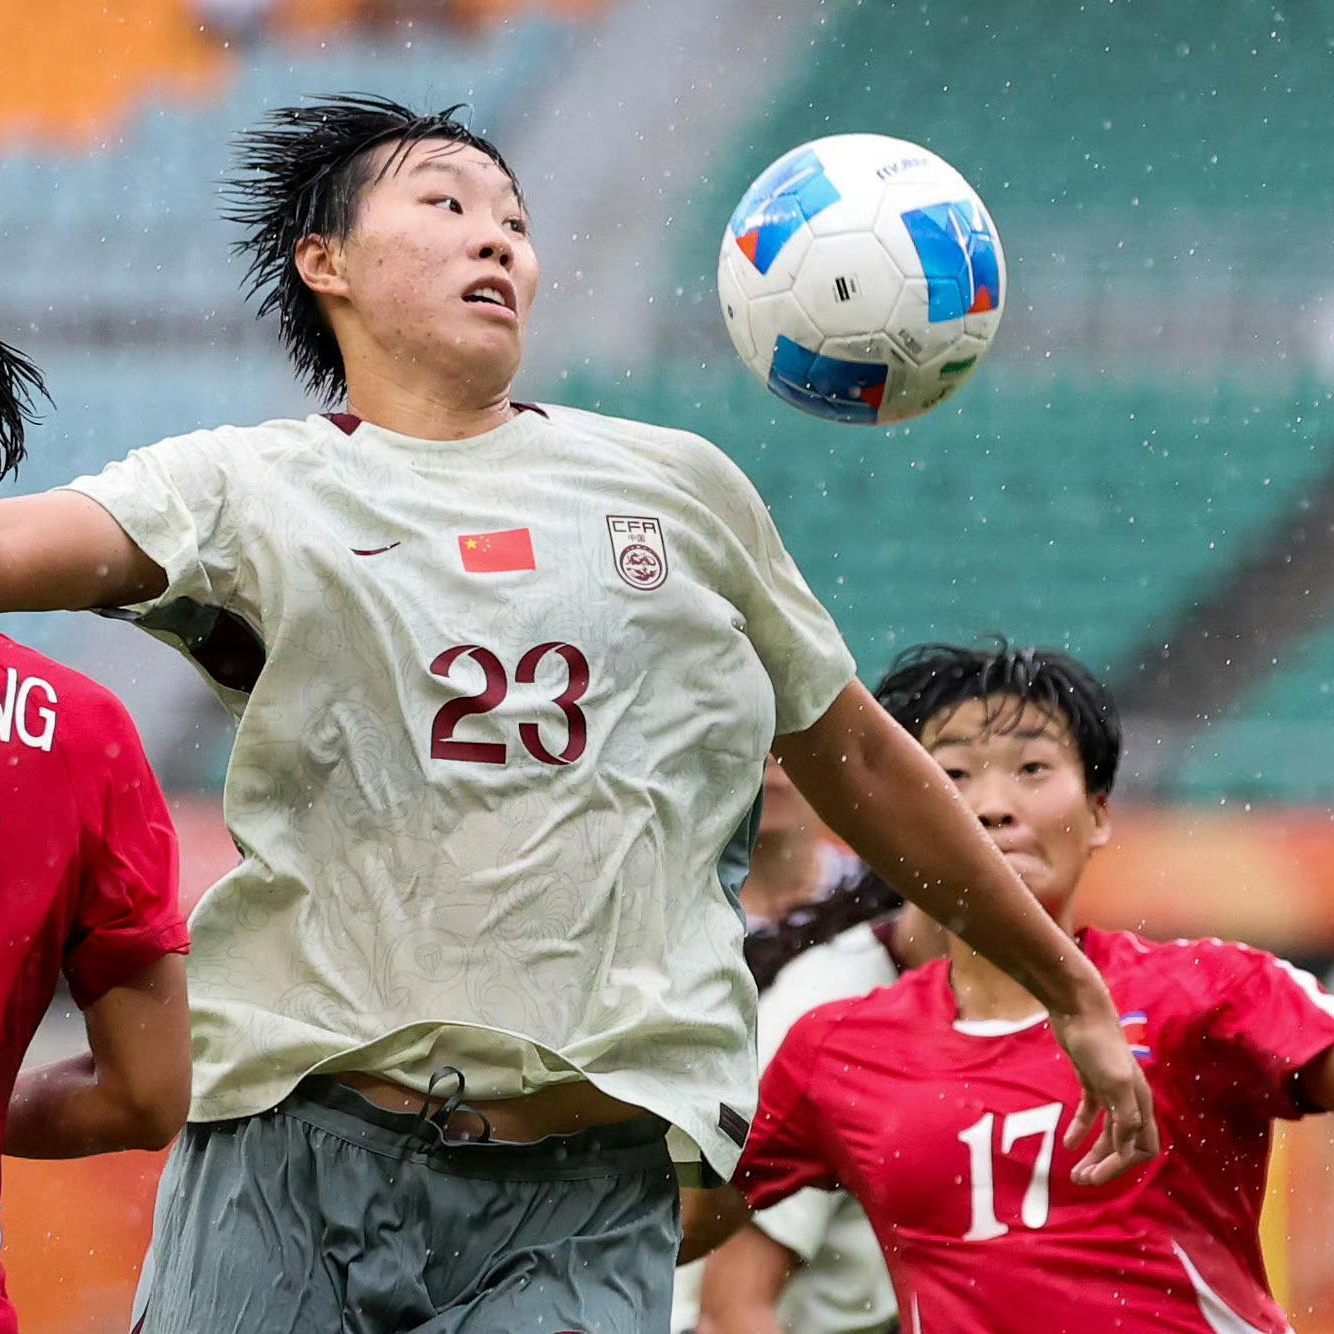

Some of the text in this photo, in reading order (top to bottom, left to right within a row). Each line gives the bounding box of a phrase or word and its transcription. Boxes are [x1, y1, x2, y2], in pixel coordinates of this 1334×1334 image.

[612, 521, 656, 534] CFA
[429, 640, 591, 766] 23
[957, 1102, 1064, 1242] 17
